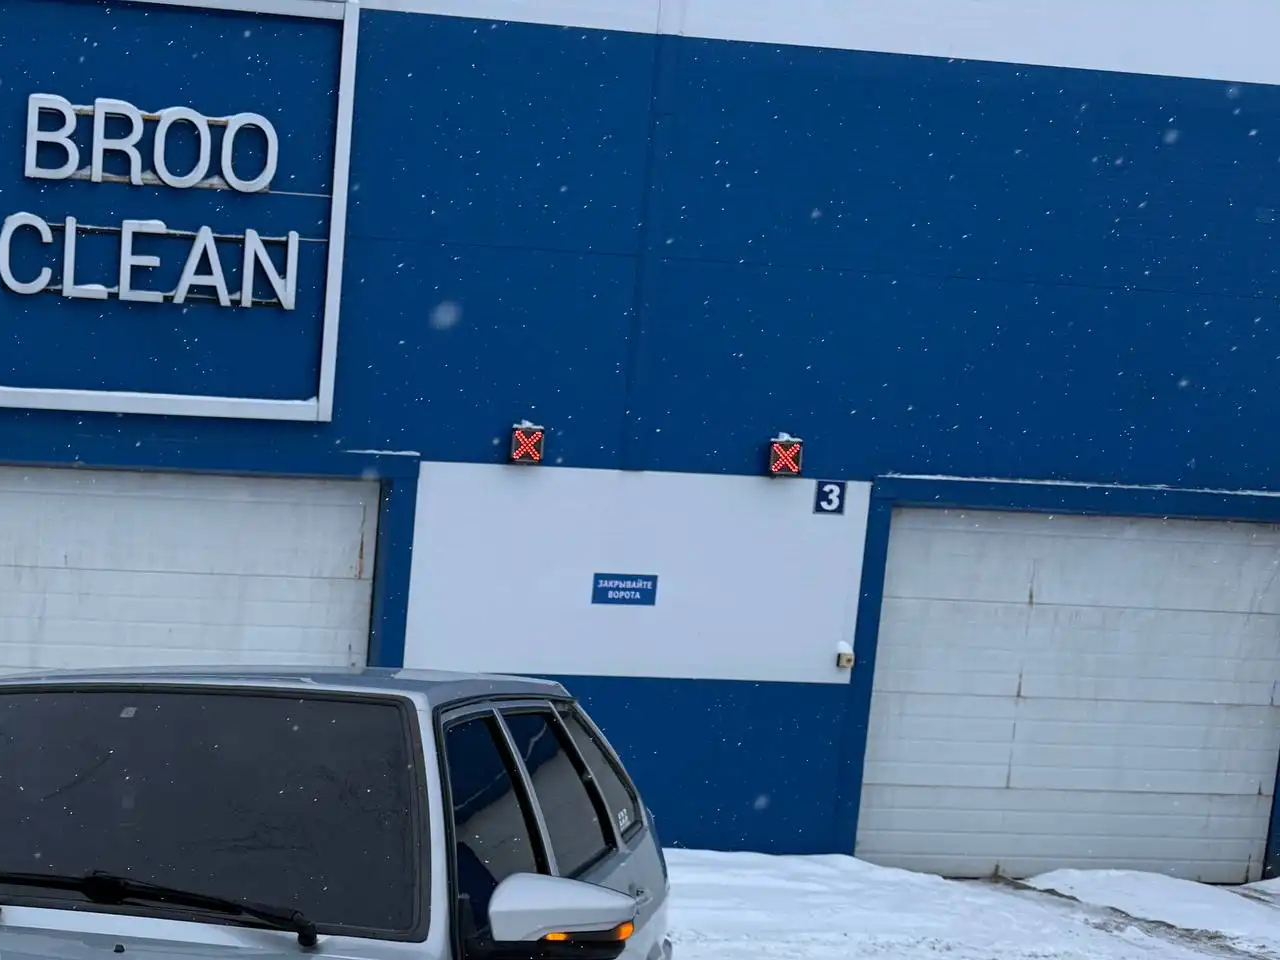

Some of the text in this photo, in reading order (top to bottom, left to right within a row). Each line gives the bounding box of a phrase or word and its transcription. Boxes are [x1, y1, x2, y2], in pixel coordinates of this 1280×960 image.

[25, 93, 279, 193] BROO
[820, 484, 840, 511] 3
[597, 579, 653, 590] ЗАКРЫВАЙТЕ
[607, 590, 641, 599] ВОРОТА
